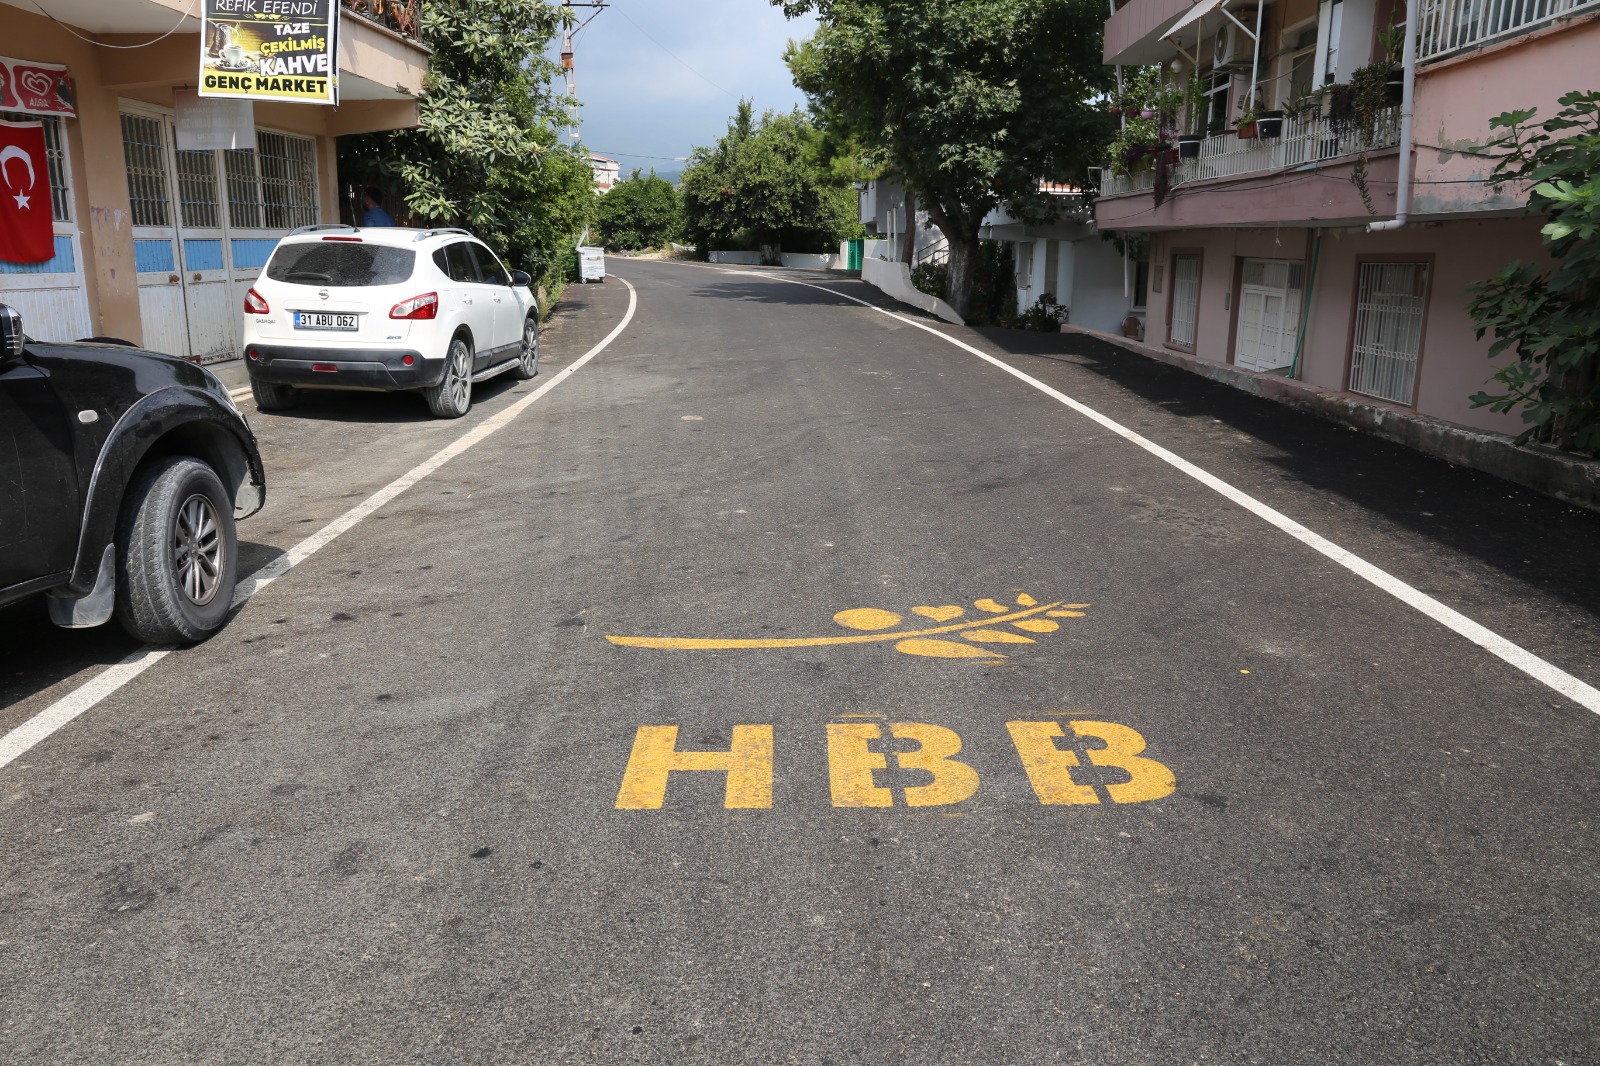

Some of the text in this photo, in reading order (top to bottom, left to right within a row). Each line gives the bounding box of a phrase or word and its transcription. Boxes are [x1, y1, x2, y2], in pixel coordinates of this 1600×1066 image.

[262, 0, 318, 15] EFENDİ
[273, 22, 311, 36] TAZE
[260, 34, 326, 57] ÇEKİLMİŞ
[259, 53, 328, 77] KAHVE
[204, 74, 327, 93] GENÇ MARKET
[300, 314, 312, 325] 31
[316, 315, 333, 326] ABU
[336, 316, 354, 327] 062
